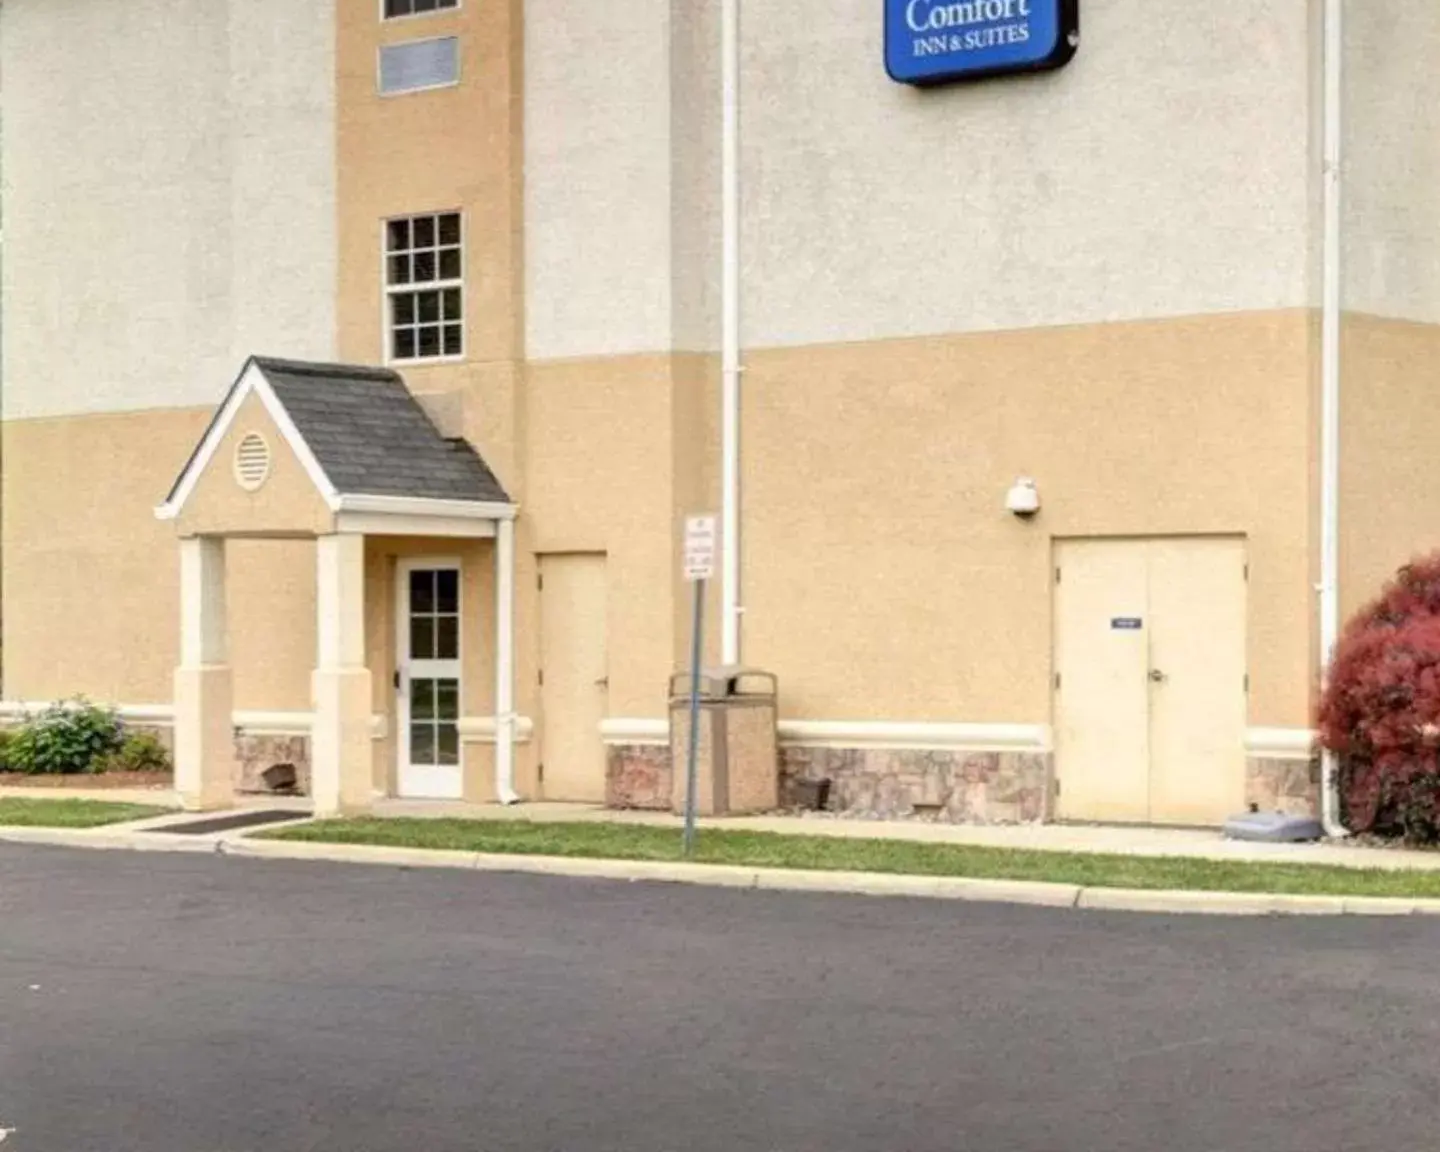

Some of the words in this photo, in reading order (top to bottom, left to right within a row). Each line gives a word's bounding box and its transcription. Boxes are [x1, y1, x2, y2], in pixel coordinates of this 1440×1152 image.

[913, 34, 948, 57] INN
[949, 34, 963, 51] &
[965, 23, 1029, 50] SUITES
